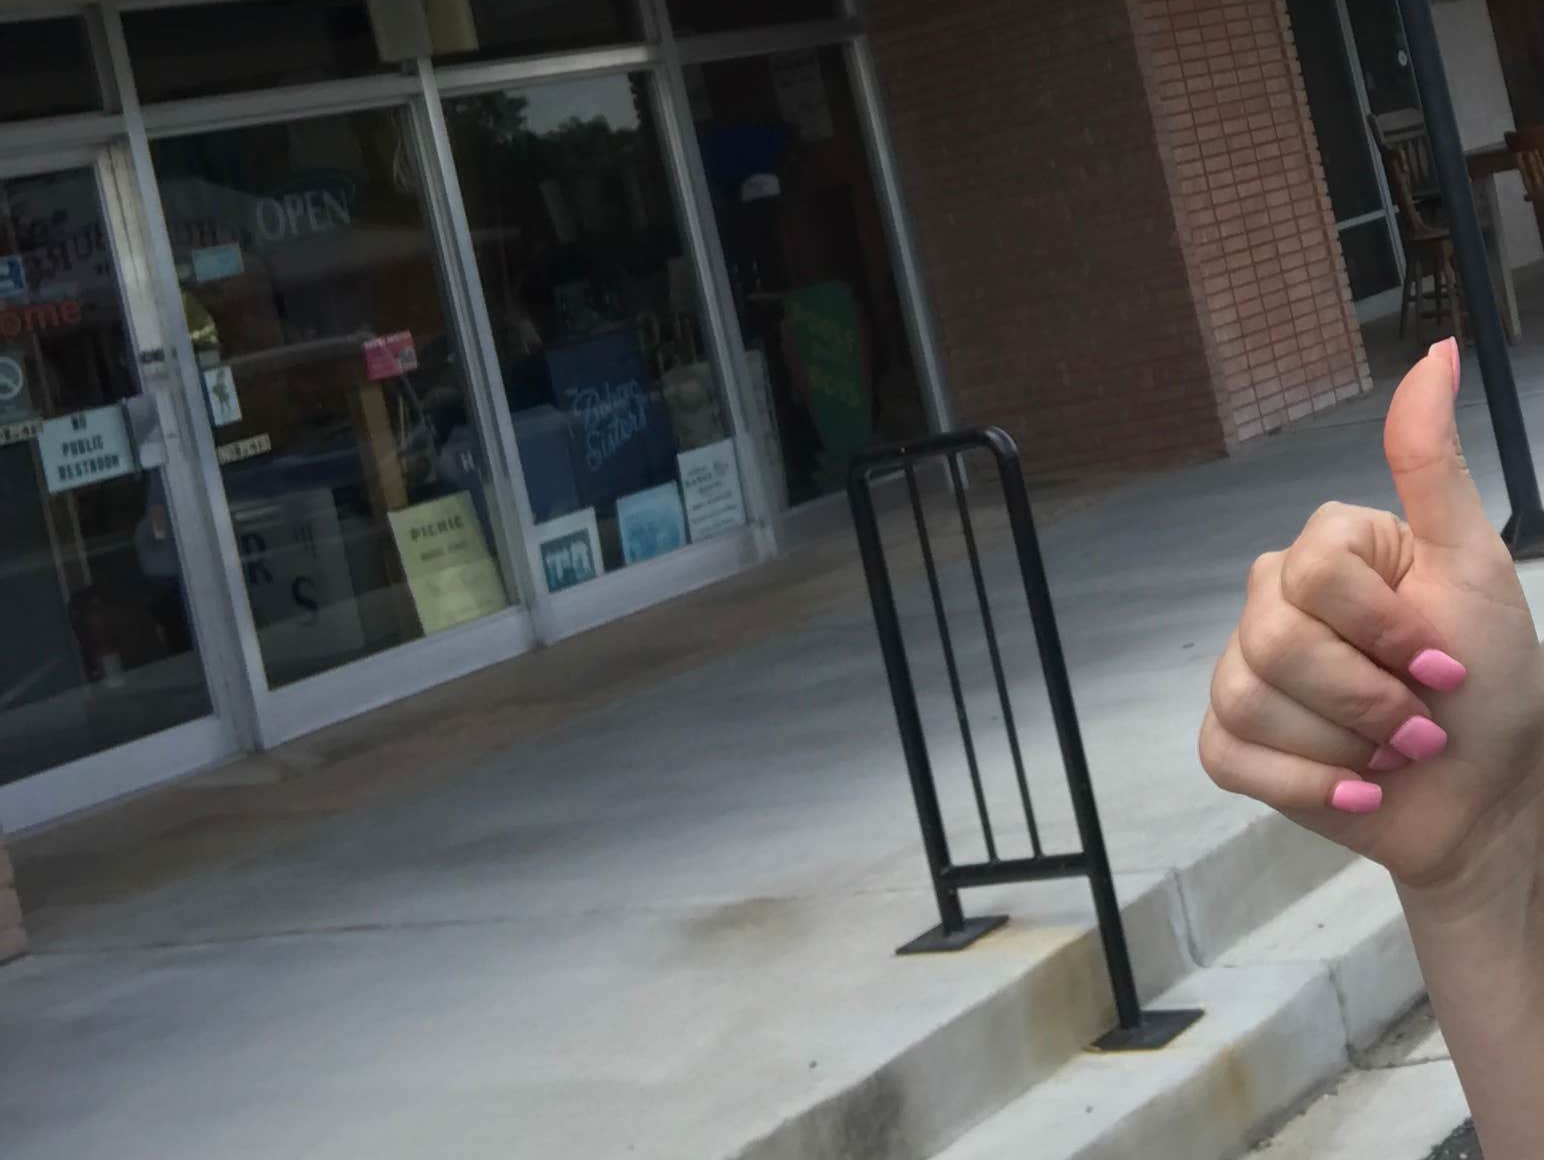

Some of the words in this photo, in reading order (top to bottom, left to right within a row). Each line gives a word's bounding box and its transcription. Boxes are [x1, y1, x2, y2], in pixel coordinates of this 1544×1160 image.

[255, 186, 351, 240] OPEN
[70, 413, 88, 432] NO
[61, 434, 104, 457] PUBLIC
[409, 514, 465, 543] PICNIC
